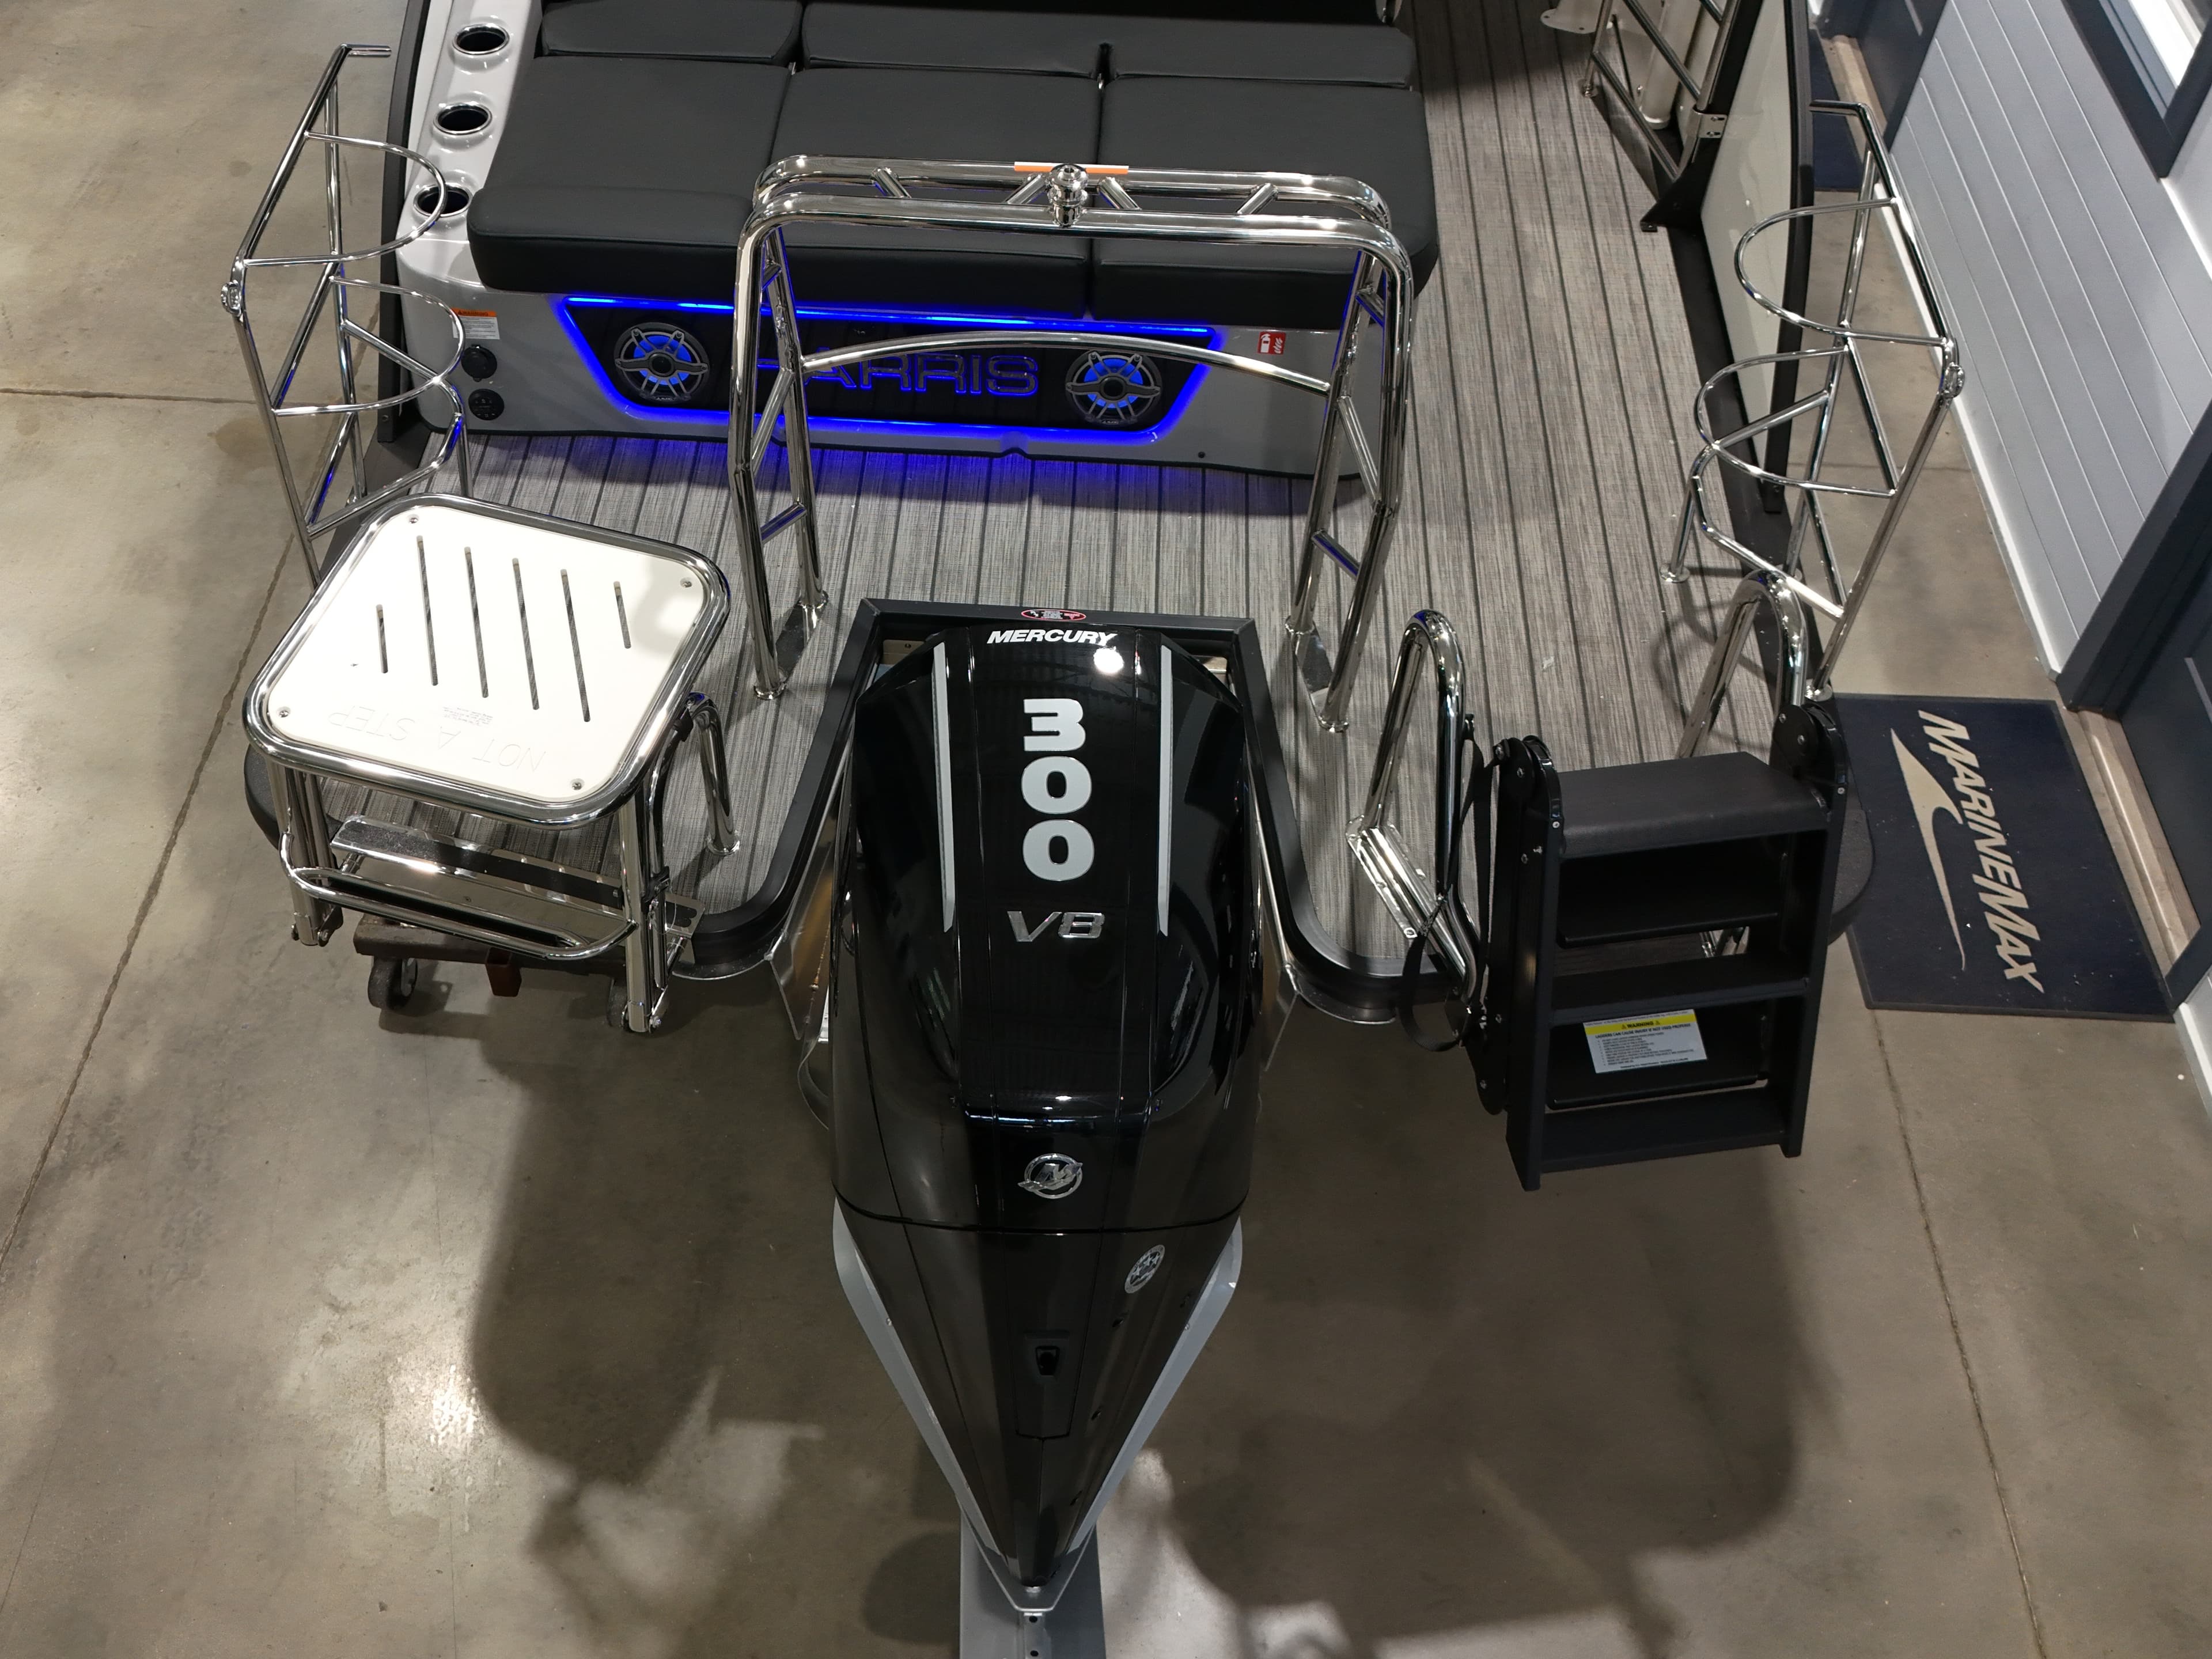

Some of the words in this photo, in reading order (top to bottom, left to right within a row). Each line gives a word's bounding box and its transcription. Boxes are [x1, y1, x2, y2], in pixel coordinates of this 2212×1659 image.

[987, 629, 1118, 646] MERCURY
[327, 705, 415, 741] STEP
[437, 726, 461, 751] A
[471, 738, 547, 774] NOT
[1021, 698, 1094, 881] 300
[1007, 911, 1105, 942] V8
[1626, 1020, 1654, 1028] WARNING
